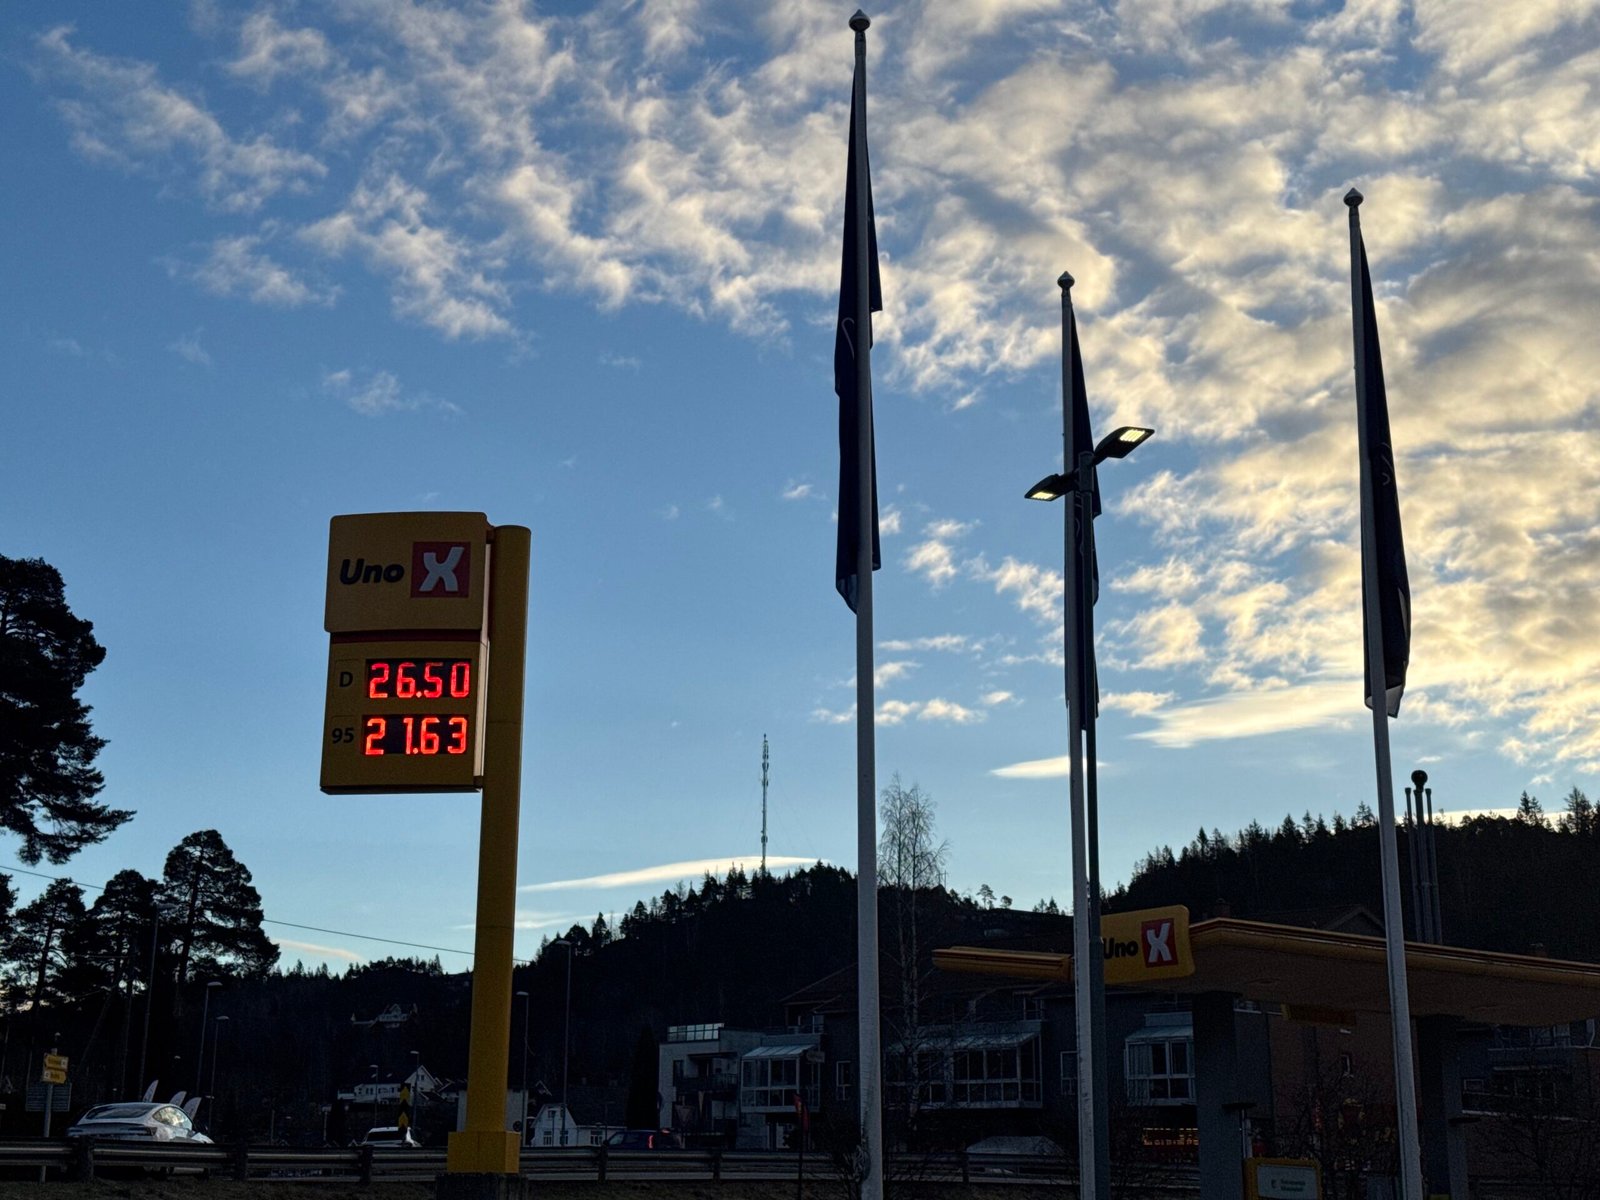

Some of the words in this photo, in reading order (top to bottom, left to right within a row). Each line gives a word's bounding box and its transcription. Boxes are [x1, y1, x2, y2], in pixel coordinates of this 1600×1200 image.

[340, 558, 405, 585] Uno
[418, 545, 465, 593] X
[339, 671, 353, 688] D
[368, 662, 471, 699] 26.50
[331, 727, 355, 744] 95
[364, 717, 469, 756] 21.63
[1103, 937, 1139, 959] Uno
[1146, 922, 1173, 964] X
